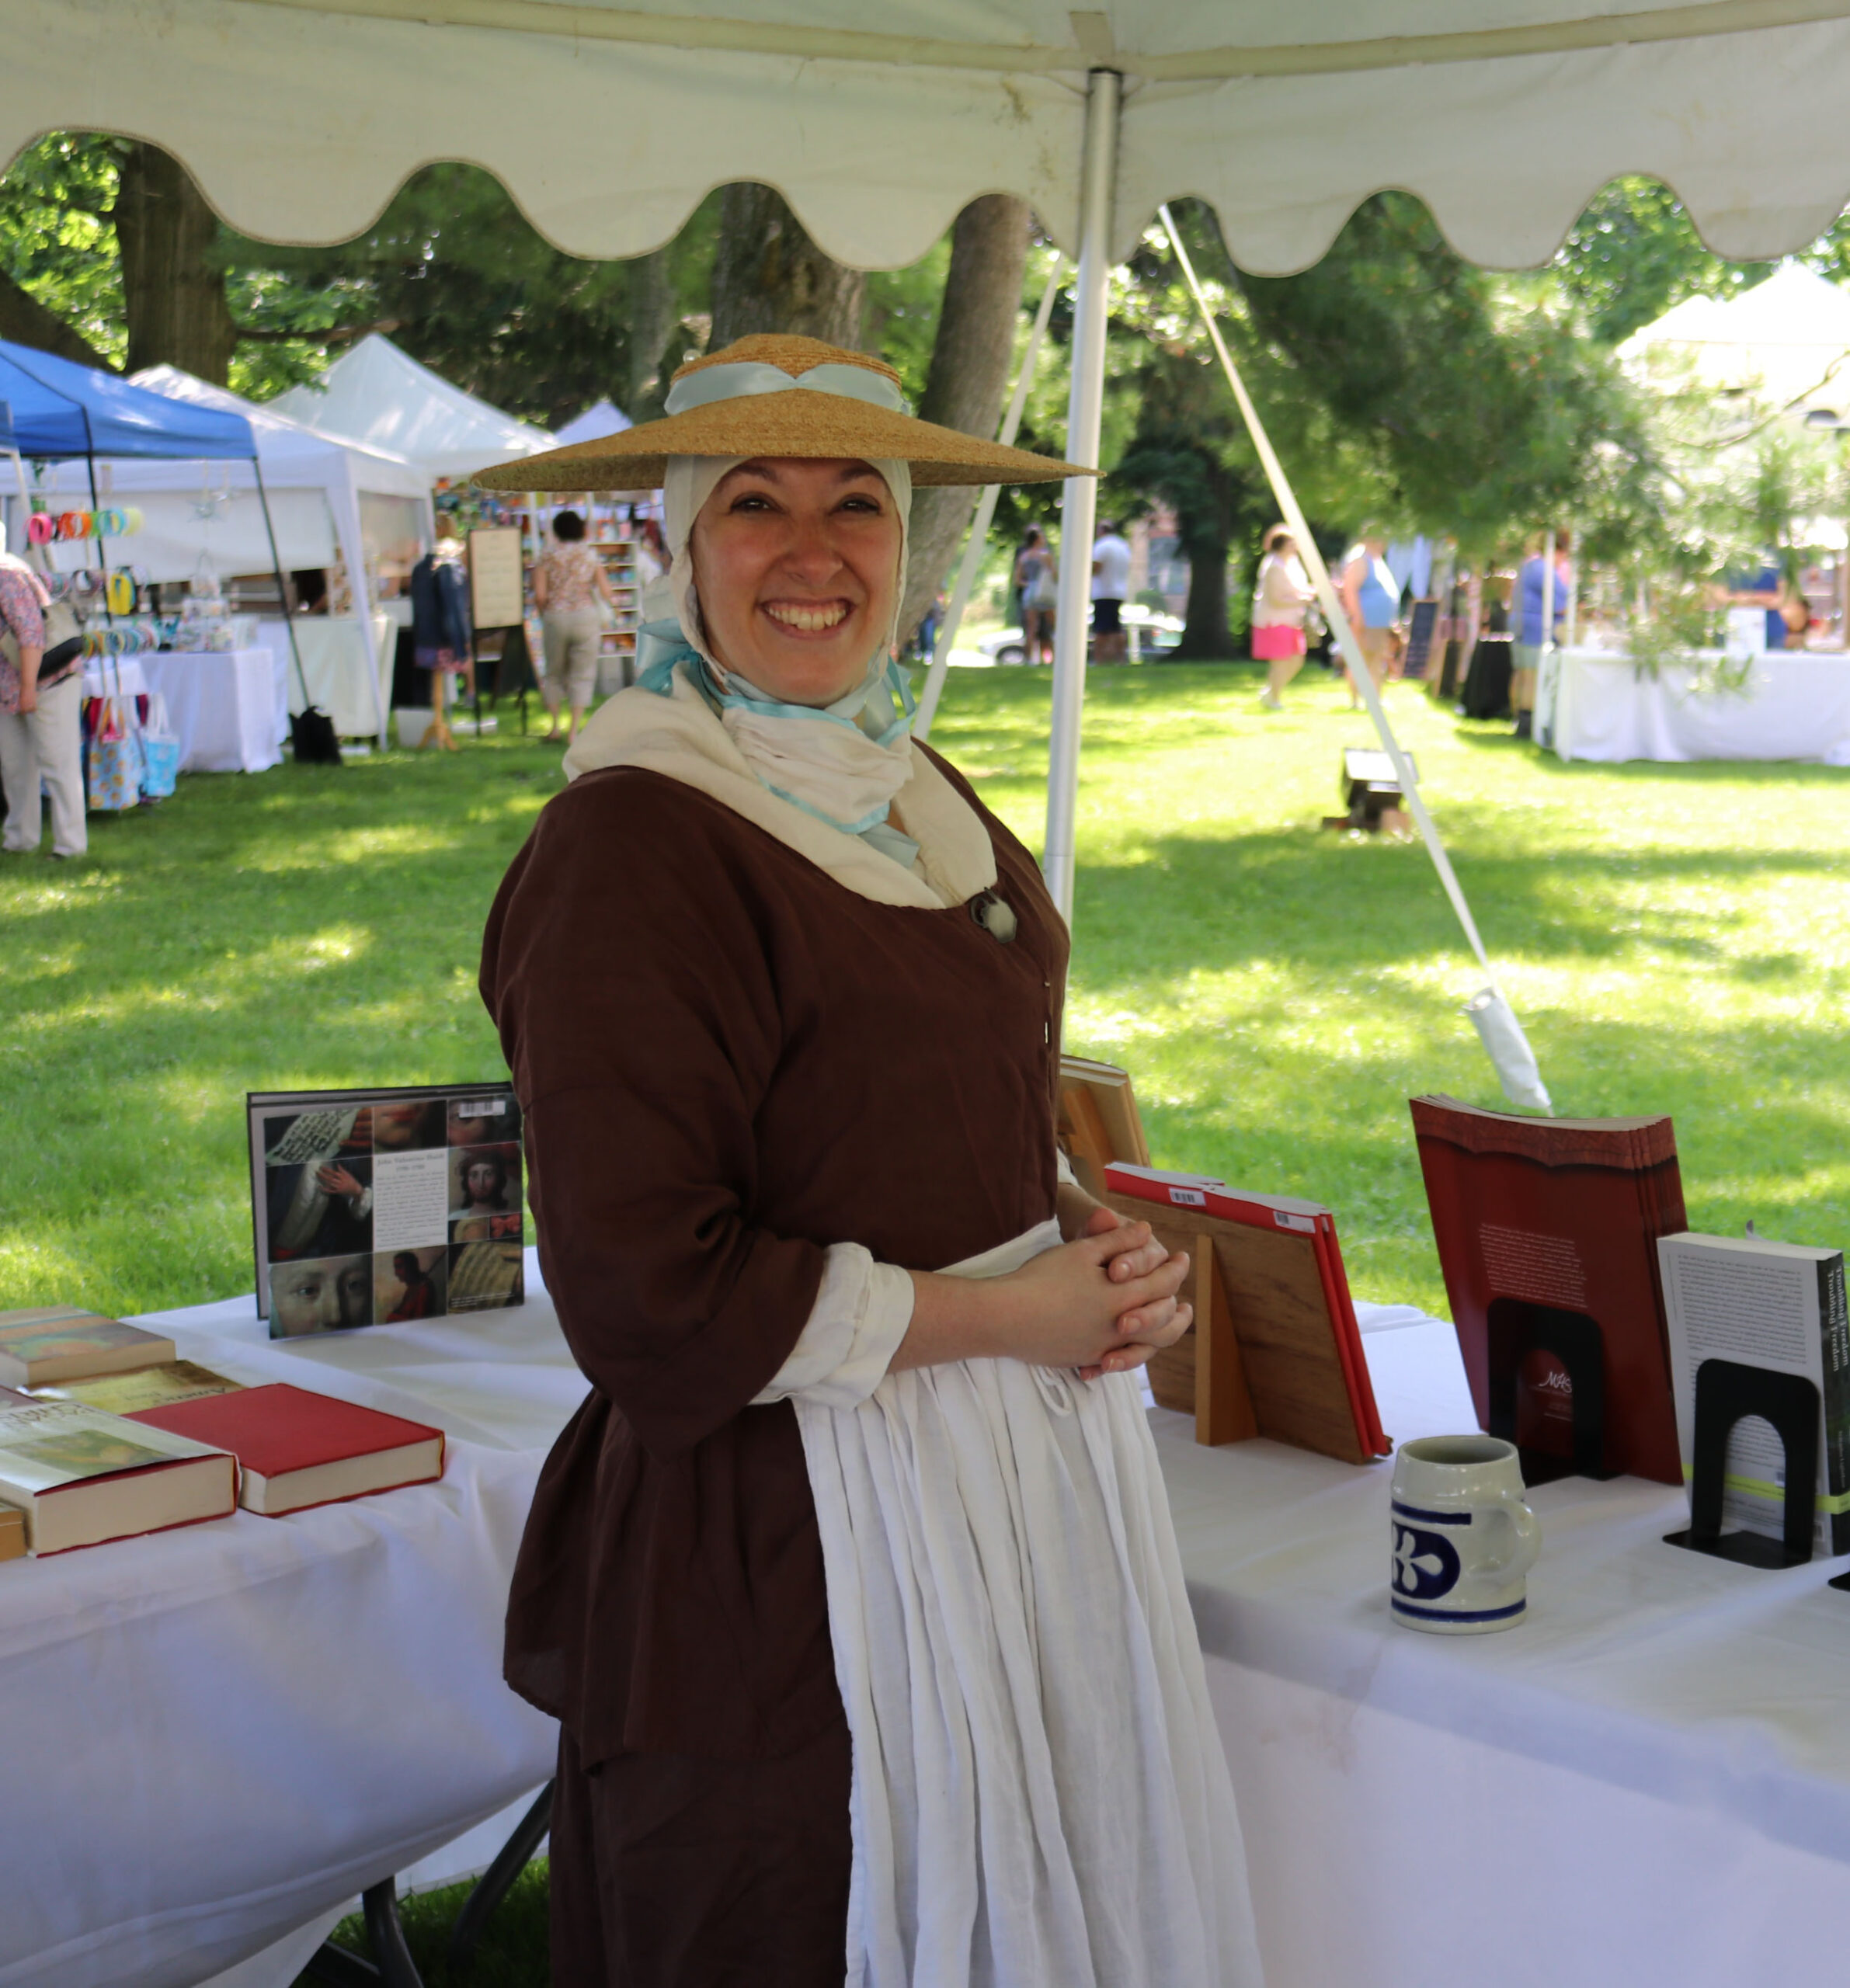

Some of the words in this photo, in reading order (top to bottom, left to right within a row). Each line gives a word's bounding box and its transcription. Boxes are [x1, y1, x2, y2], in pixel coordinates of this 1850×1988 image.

[1827, 1270, 1837, 1324] Troubling
[1836, 1265, 1845, 1319] Troubling
[1831, 1326, 1840, 1372] Freedom
[1839, 1321, 1849, 1367] Freedom
